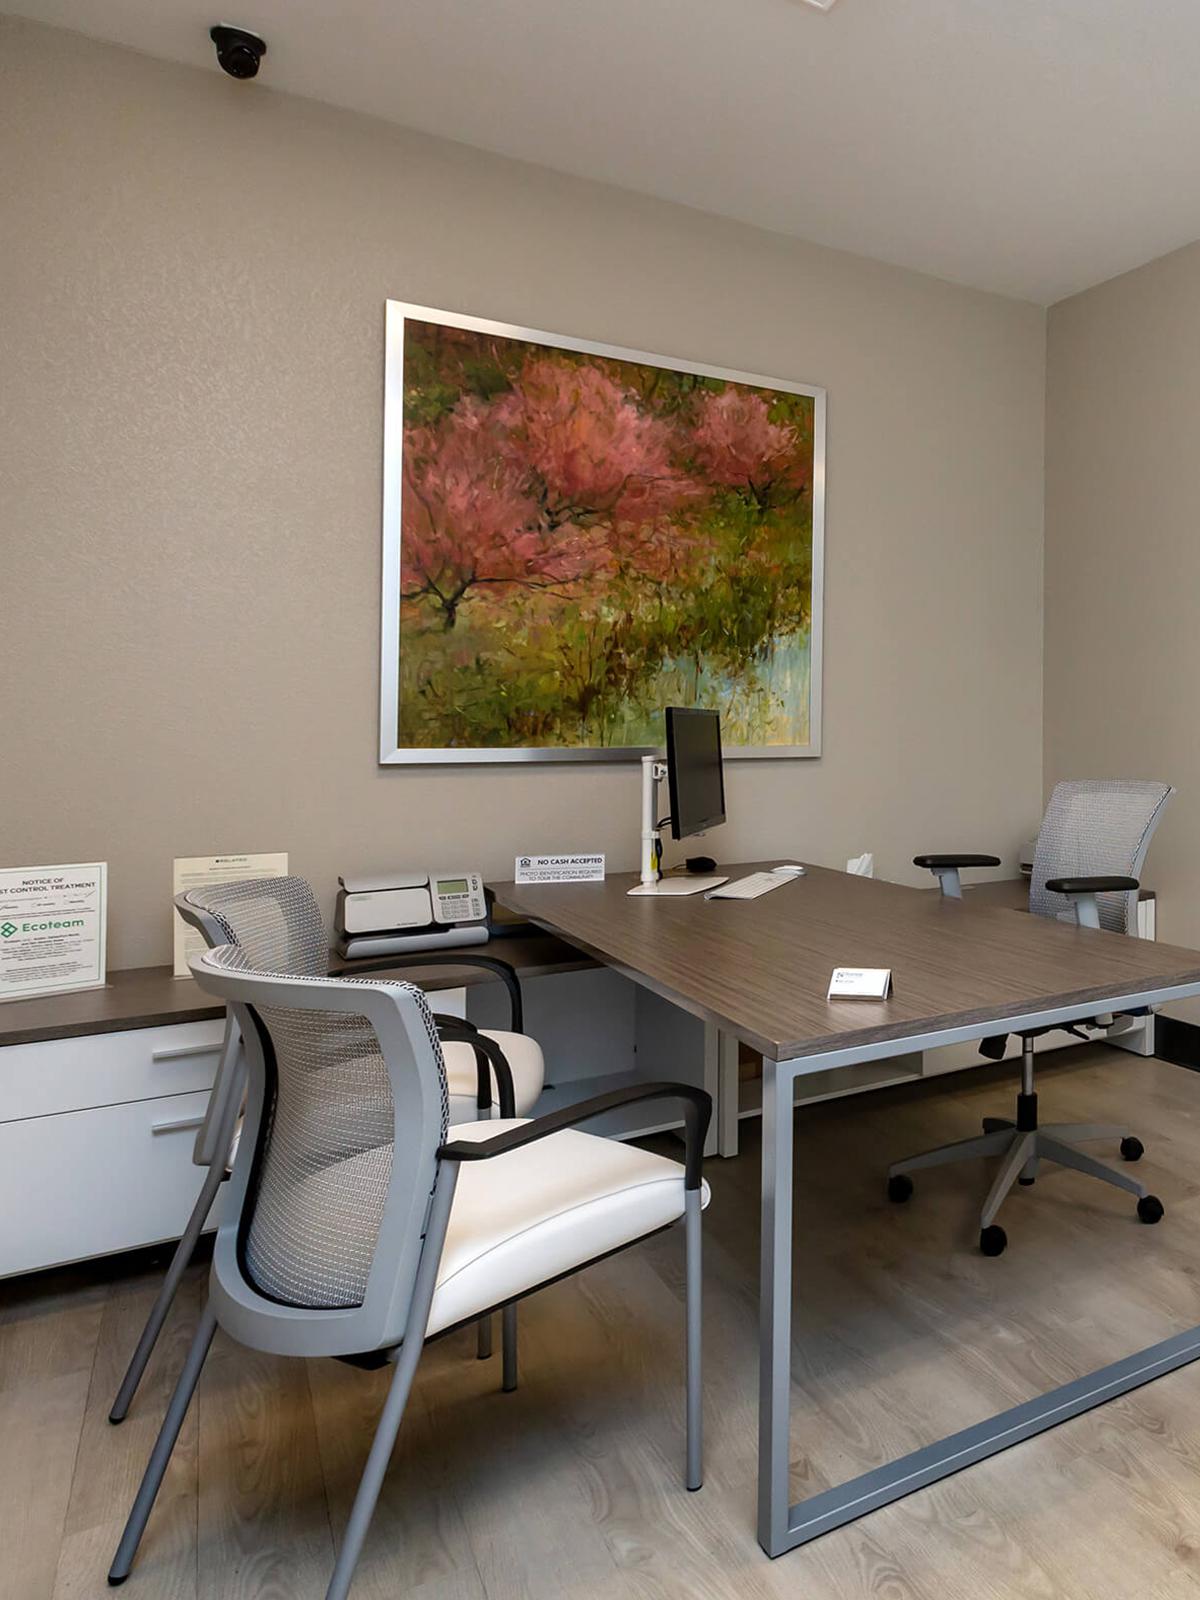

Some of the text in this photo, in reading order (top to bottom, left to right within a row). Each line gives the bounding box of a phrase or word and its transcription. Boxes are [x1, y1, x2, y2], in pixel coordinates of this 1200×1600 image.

[10, 886, 49, 894] CONTROL
[51, 882, 96, 890] TREATMENT
[22, 878, 51, 886] NOTICE
[22, 919, 84, 932] Ecoteam
